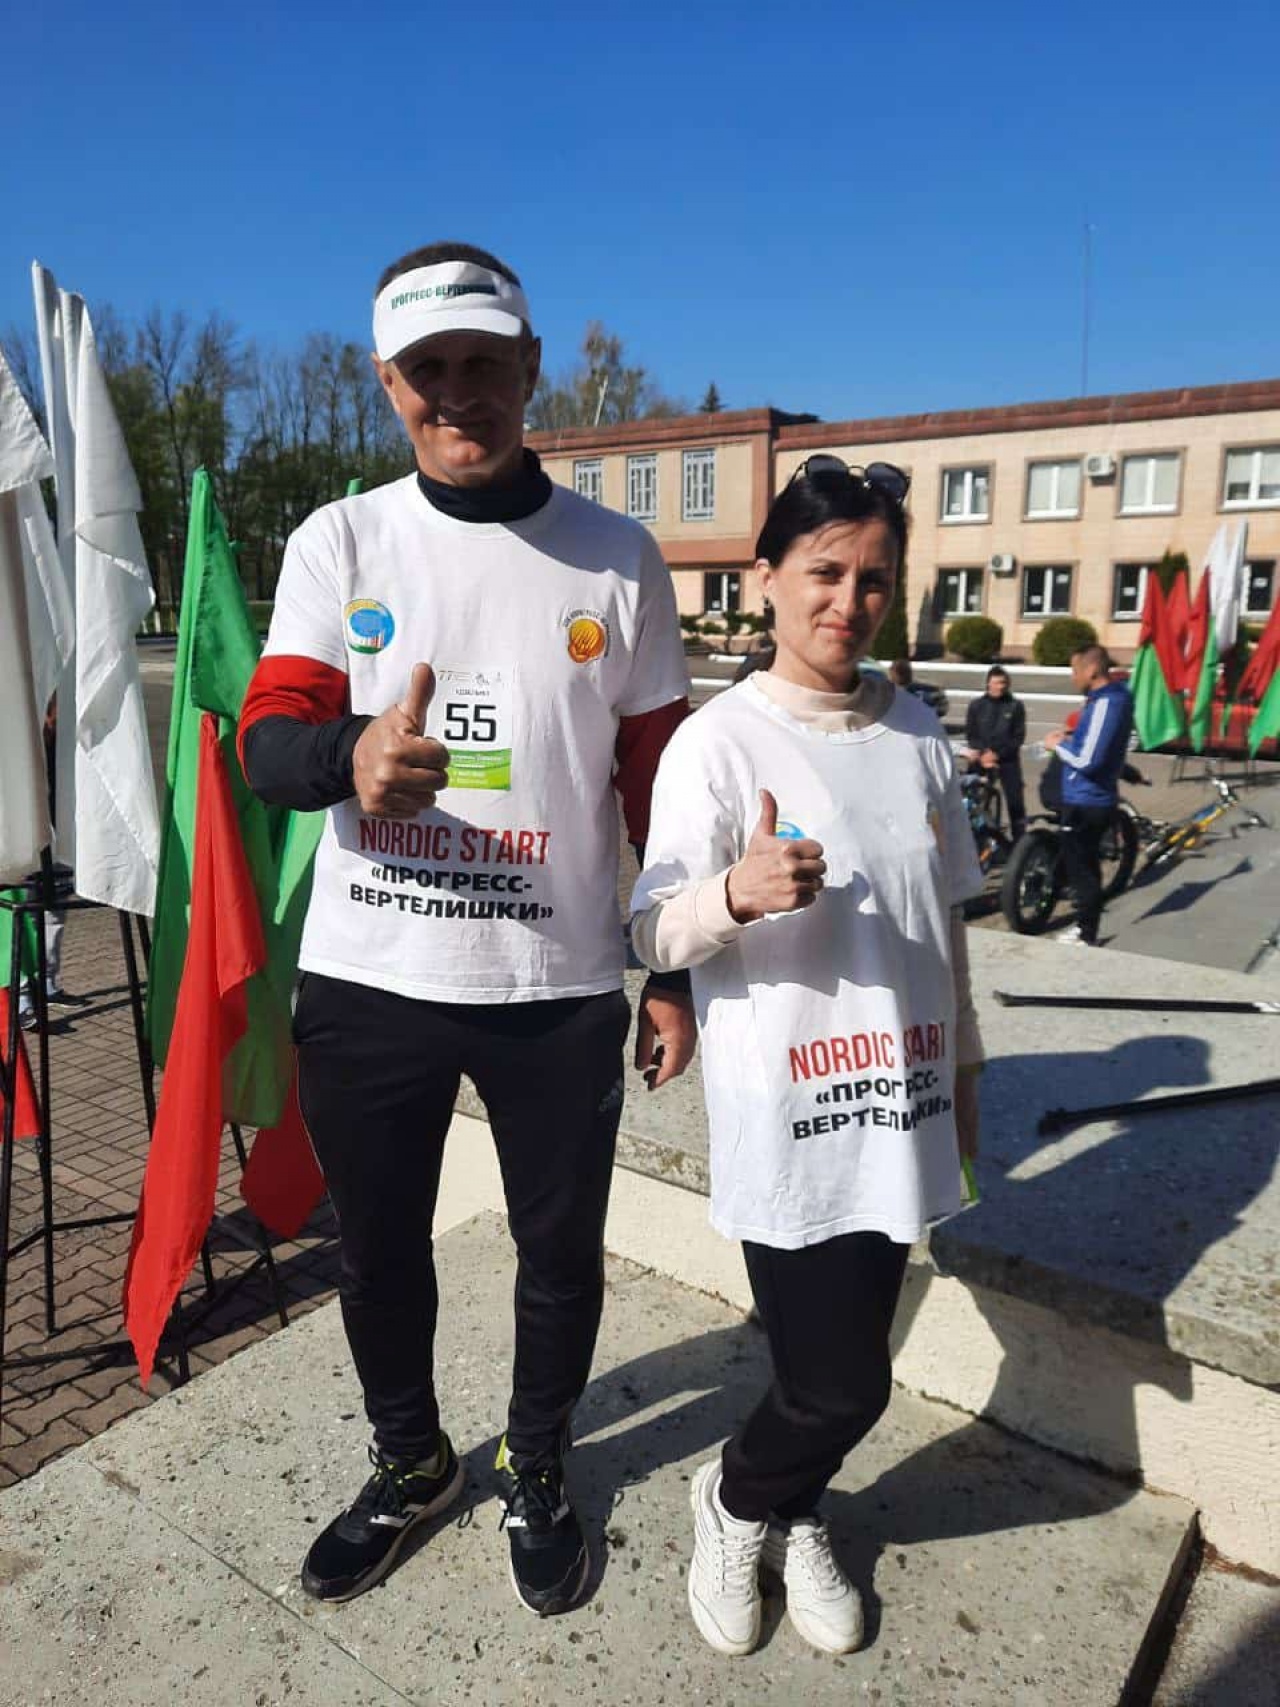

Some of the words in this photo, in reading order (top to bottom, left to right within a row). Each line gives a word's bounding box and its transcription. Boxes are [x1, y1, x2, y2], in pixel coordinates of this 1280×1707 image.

[444, 703, 497, 741] 55
[358, 818, 451, 861] NORDIC
[459, 828, 551, 865] START
[371, 864, 533, 893] «ПРОГРЕСС-
[350, 883, 553, 921] ВЕРТЕЛИШКИ»
[789, 1031, 895, 1083] NORDIC
